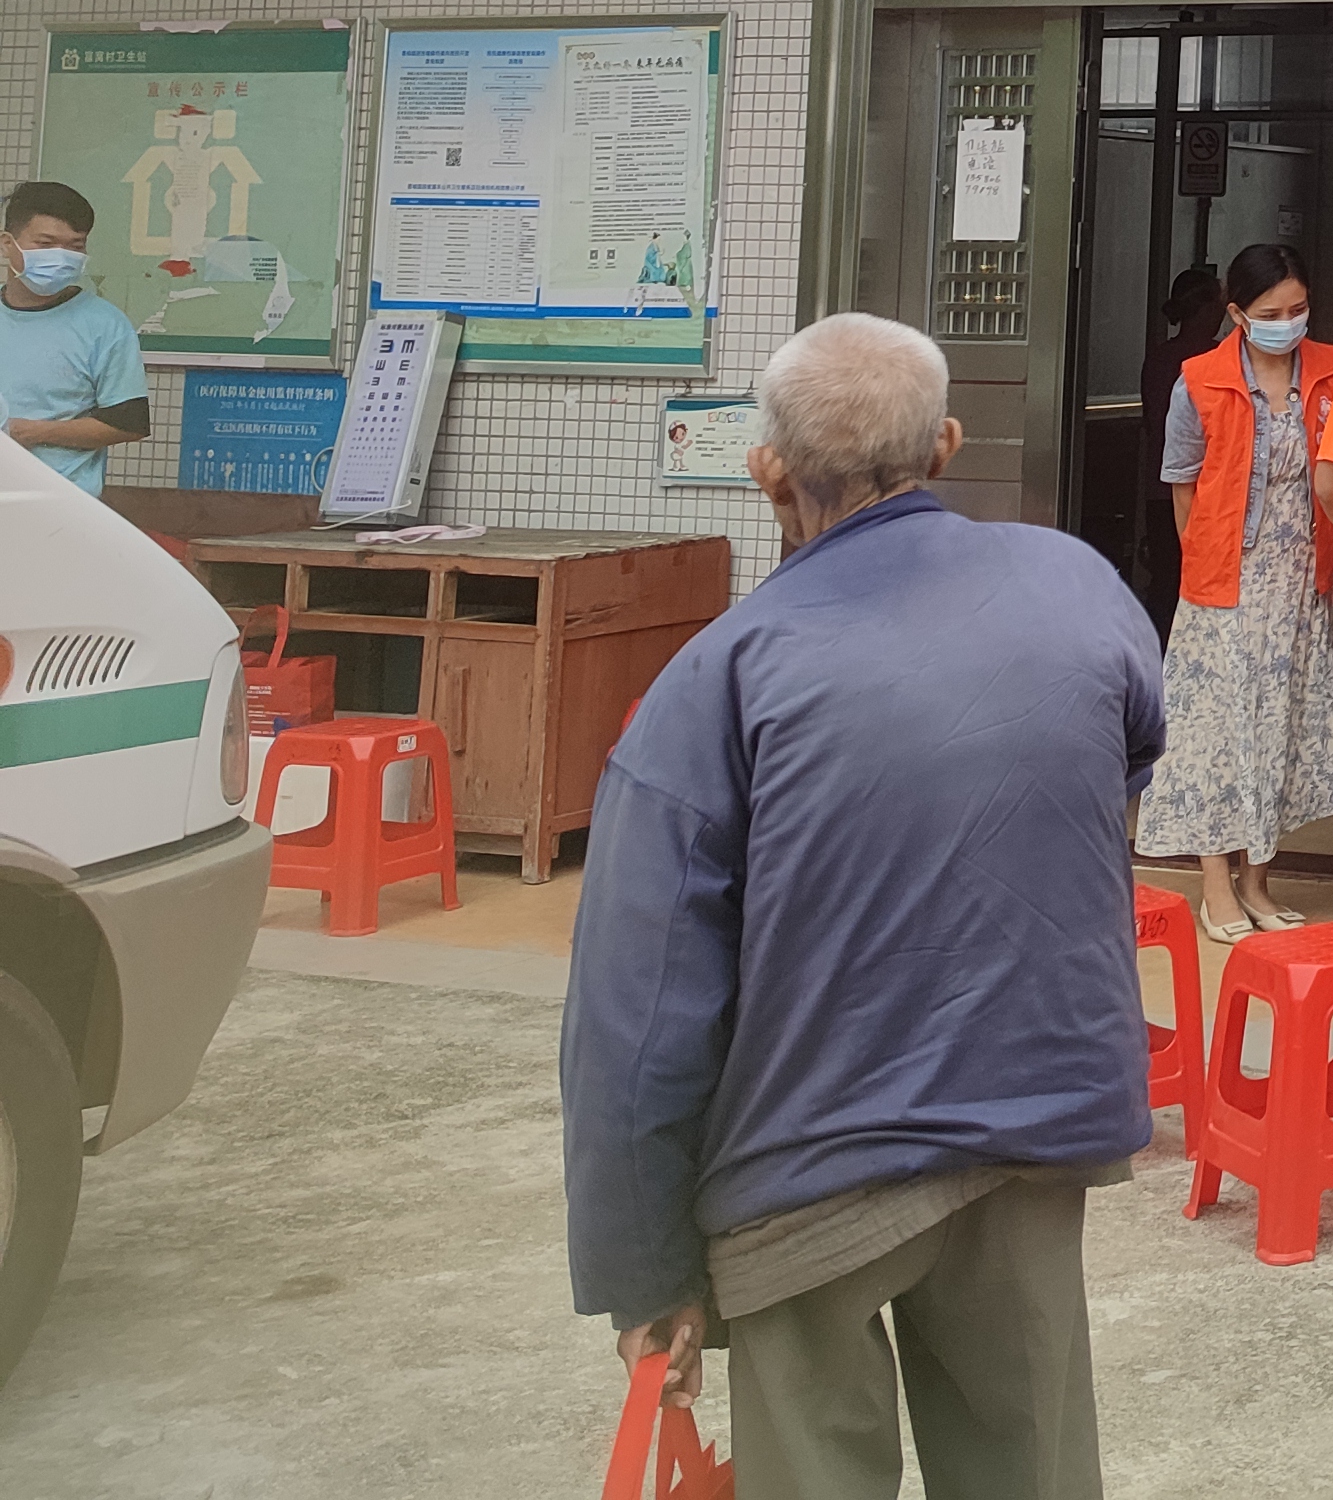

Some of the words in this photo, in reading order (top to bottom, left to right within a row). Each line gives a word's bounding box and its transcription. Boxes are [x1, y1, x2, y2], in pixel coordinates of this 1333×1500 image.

[147, 81, 249, 98] 宣传公示栏
[967, 157, 997, 171] 电话
